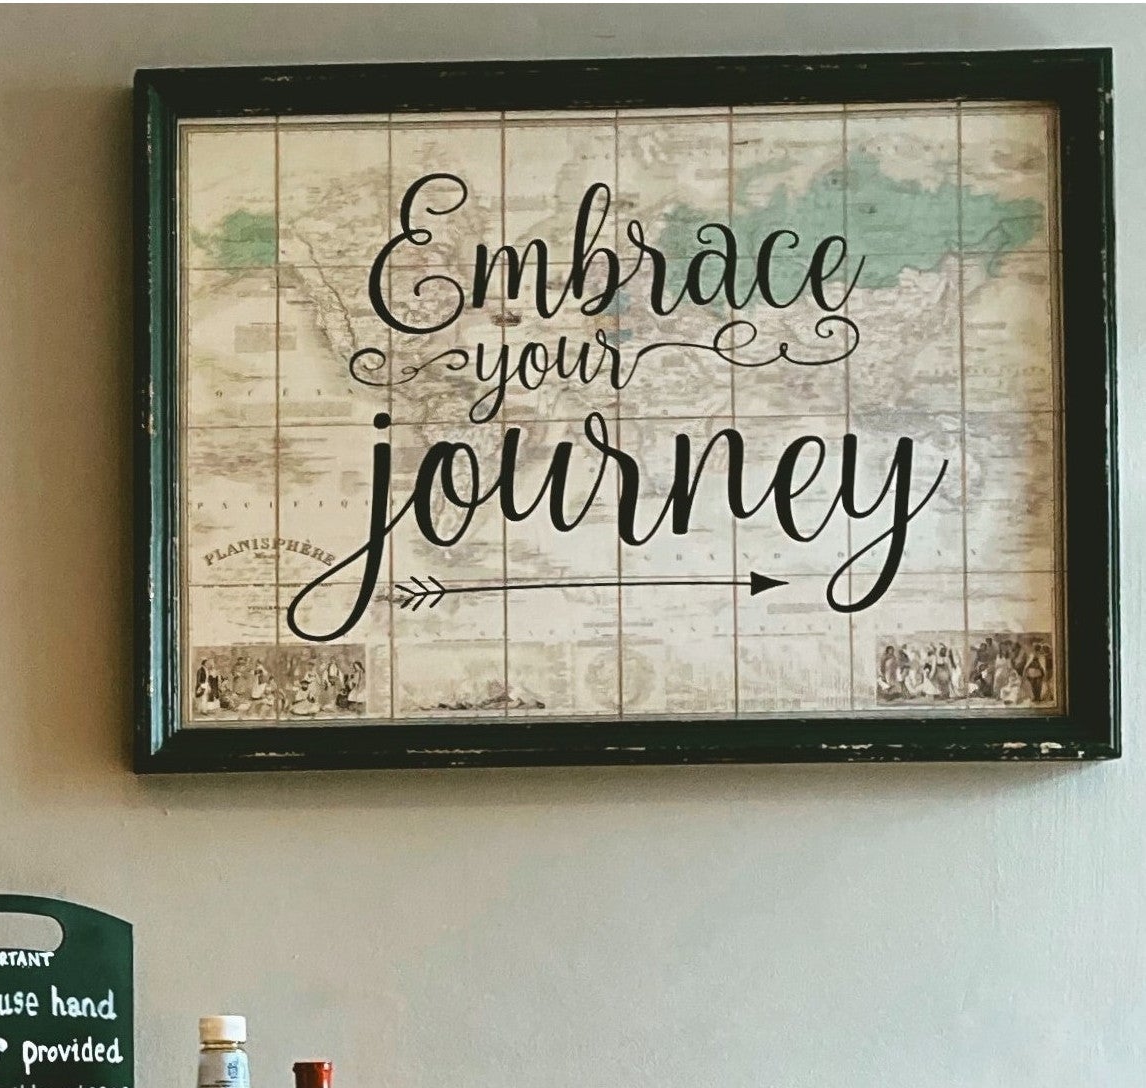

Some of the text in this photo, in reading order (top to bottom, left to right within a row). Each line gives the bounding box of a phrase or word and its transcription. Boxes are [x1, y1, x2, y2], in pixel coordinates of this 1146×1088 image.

[368, 172, 866, 335] Embrace
[287, 412, 949, 642] journey
[51, 985, 117, 1020] hand
[22, 1036, 123, 1075] provided
